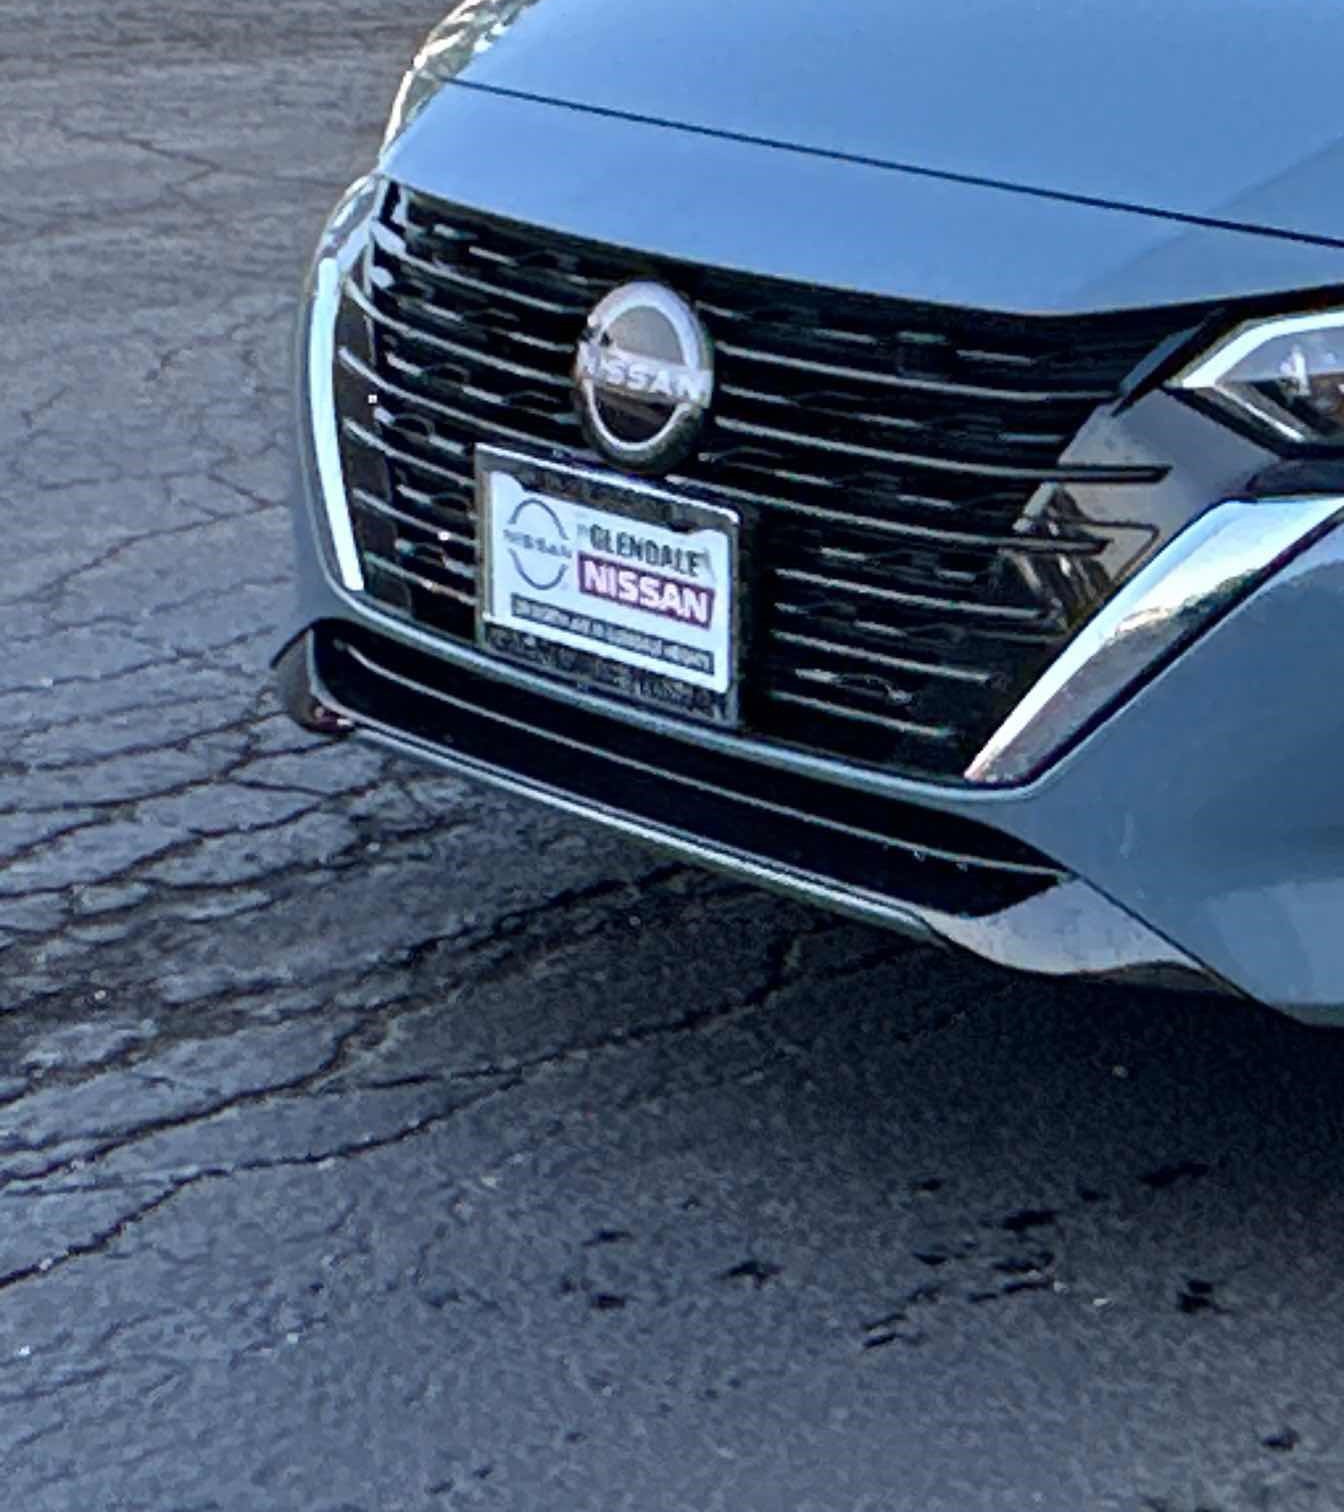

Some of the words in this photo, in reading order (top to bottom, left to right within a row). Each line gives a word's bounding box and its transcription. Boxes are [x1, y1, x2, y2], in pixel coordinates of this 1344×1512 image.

[581, 345, 710, 402] NISSAN
[590, 523, 699, 576] GLENDALE
[586, 561, 709, 623] NISSAN
